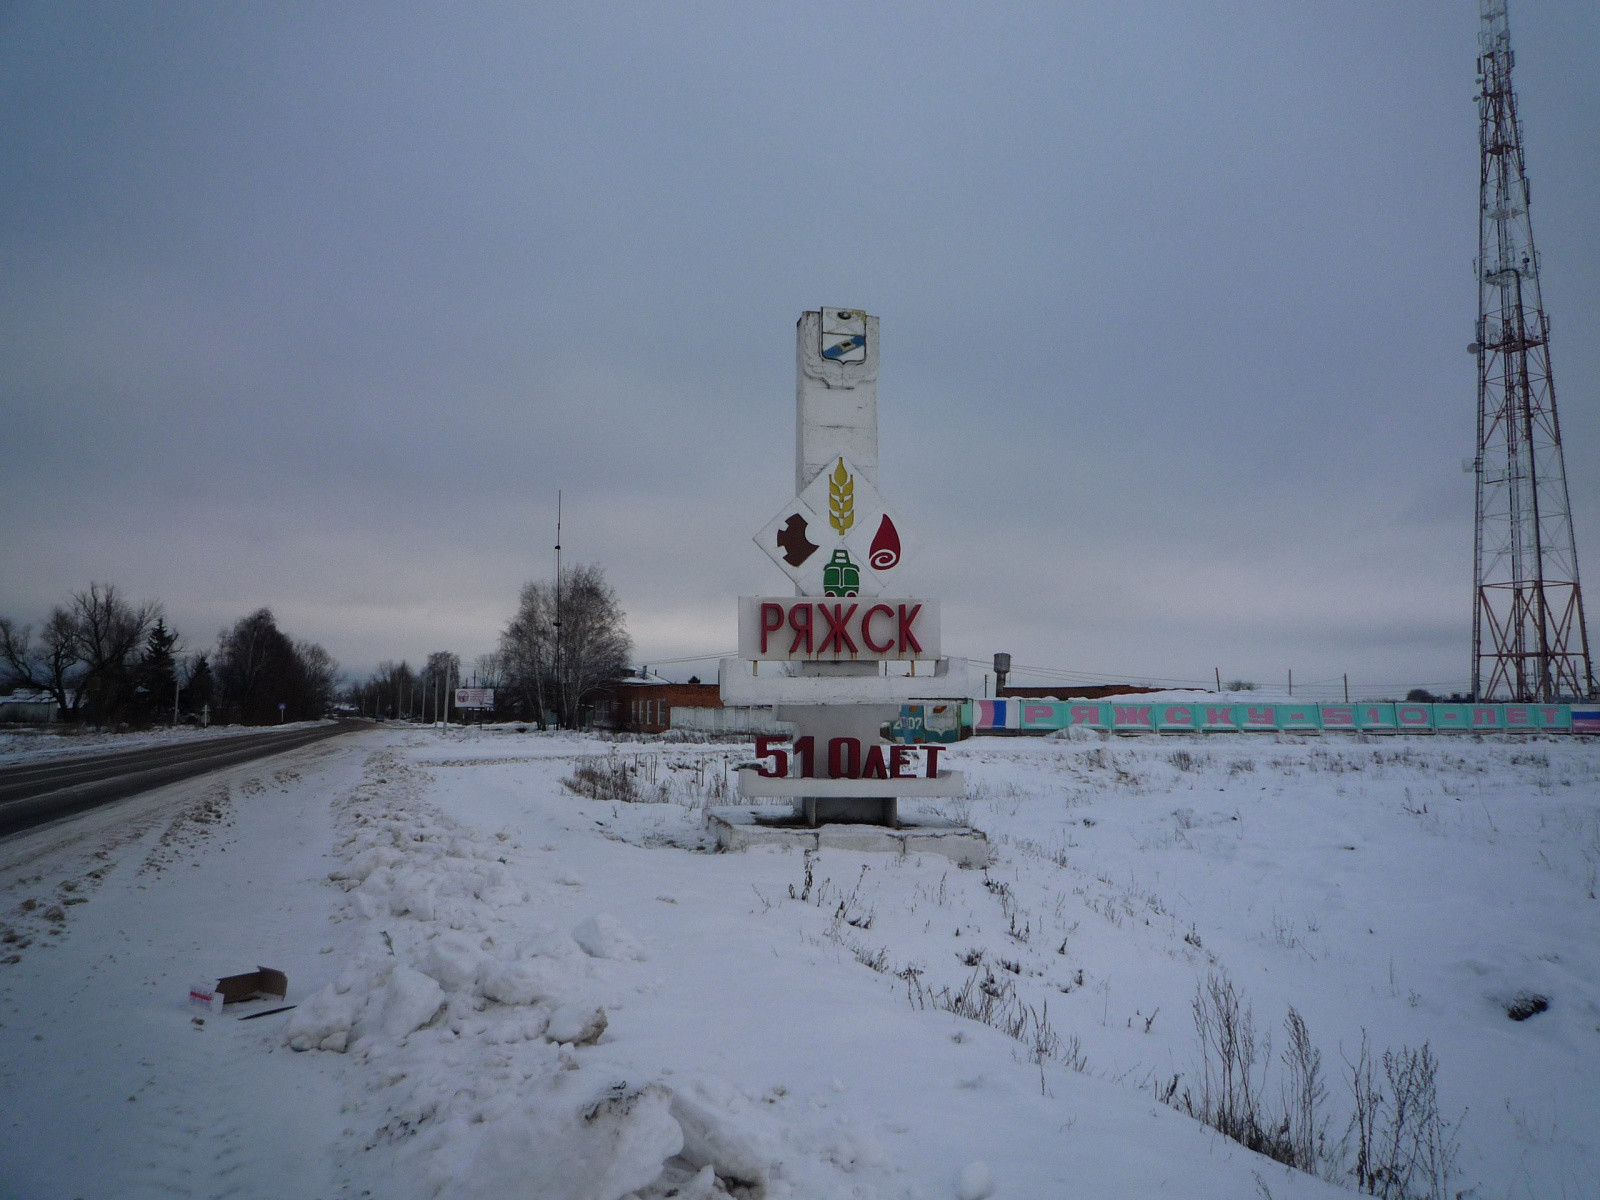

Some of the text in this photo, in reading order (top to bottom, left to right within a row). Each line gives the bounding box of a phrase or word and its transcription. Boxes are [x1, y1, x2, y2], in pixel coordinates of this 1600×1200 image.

[760, 602, 923, 654] РЯЖСК
[755, 735, 947, 779] 510 ЛЕТ
